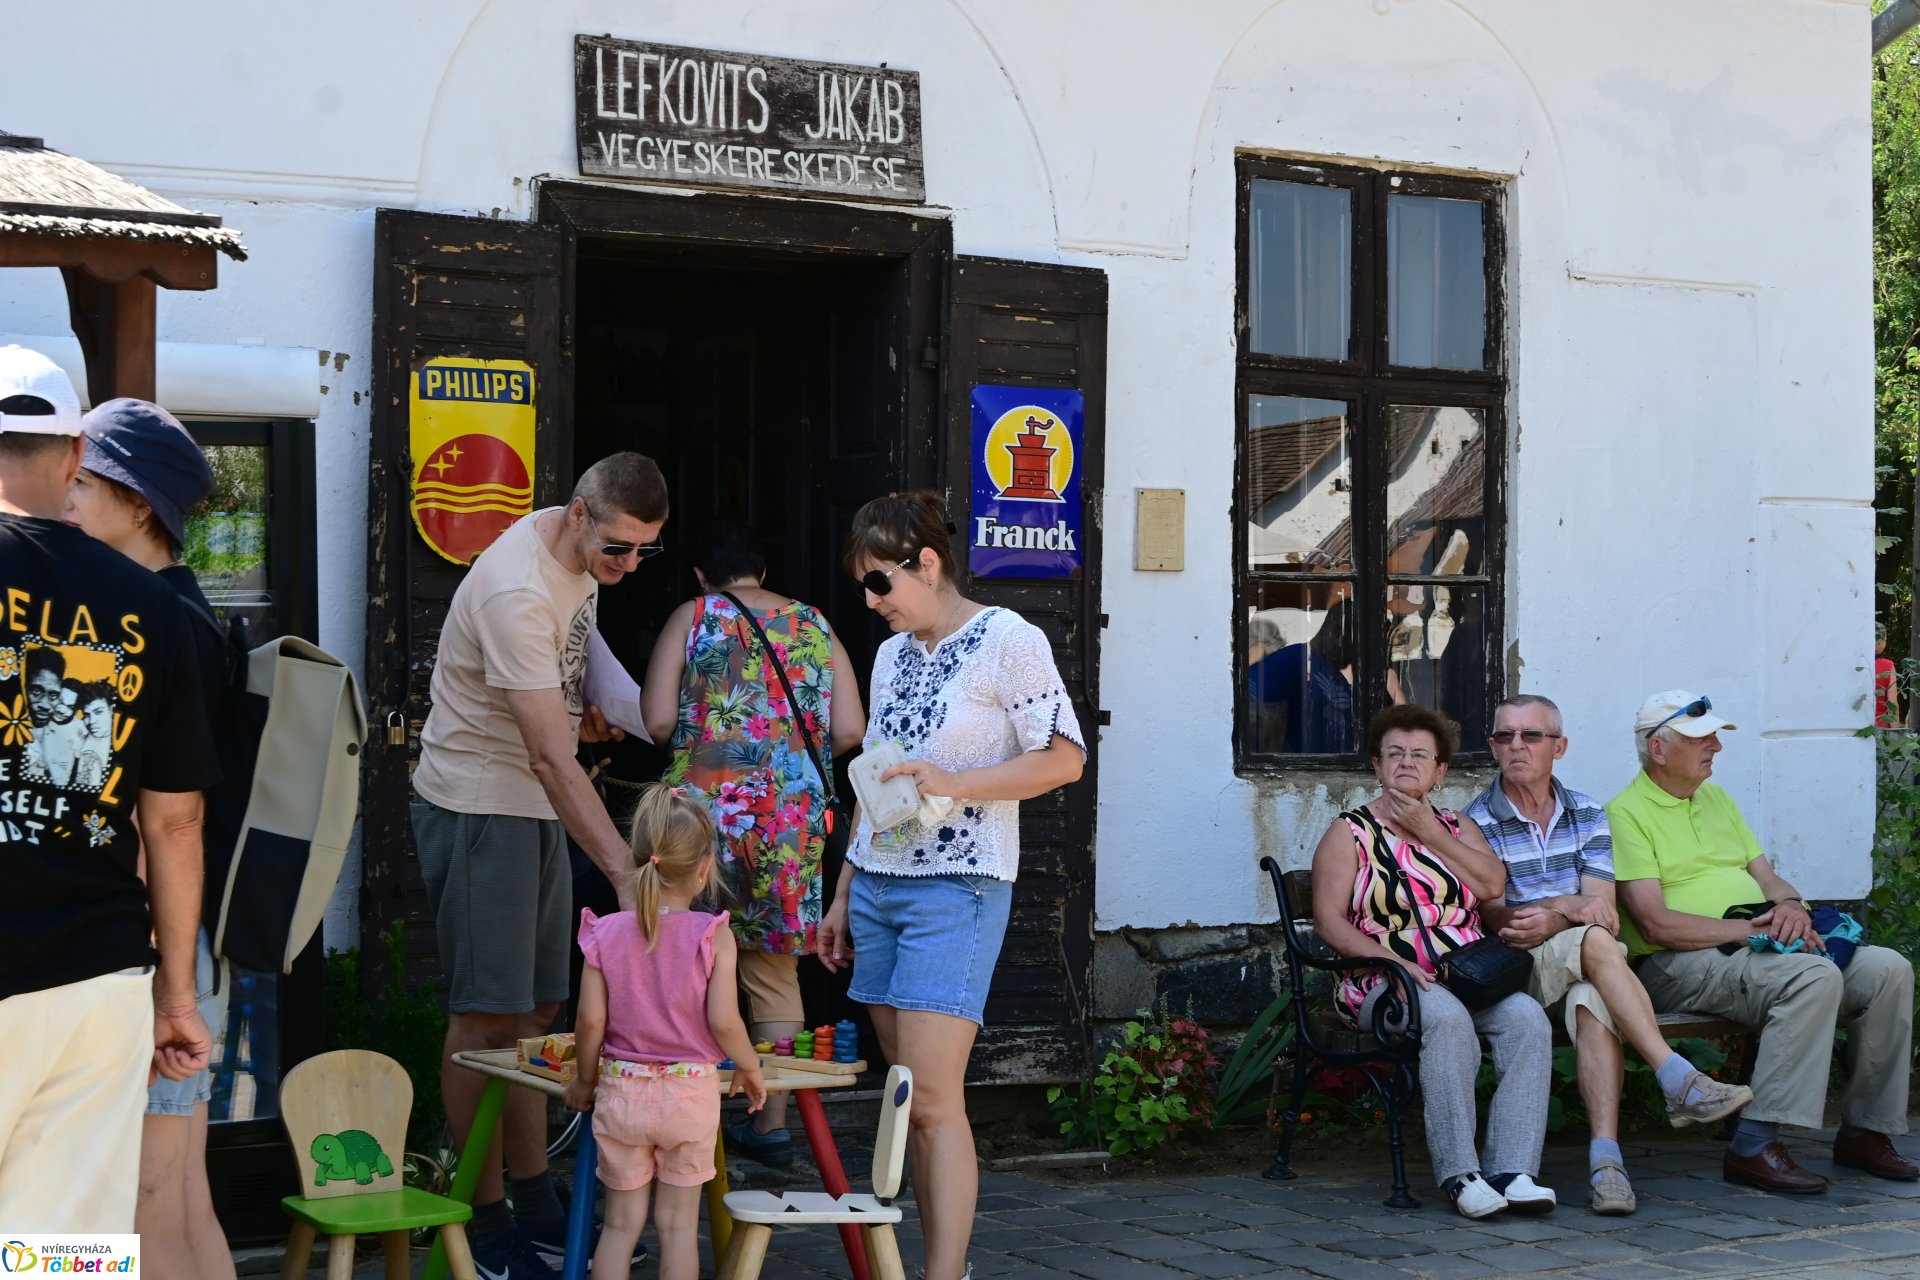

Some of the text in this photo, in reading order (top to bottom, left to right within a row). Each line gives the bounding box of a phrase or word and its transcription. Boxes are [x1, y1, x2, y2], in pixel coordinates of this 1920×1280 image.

[595, 47, 906, 144] LEFKOVITS JAKAB
[598, 131, 907, 193] VEGYESKERESKEDÉSE
[426, 369, 524, 401] PHILIPS
[974, 516, 1077, 551] Franck
